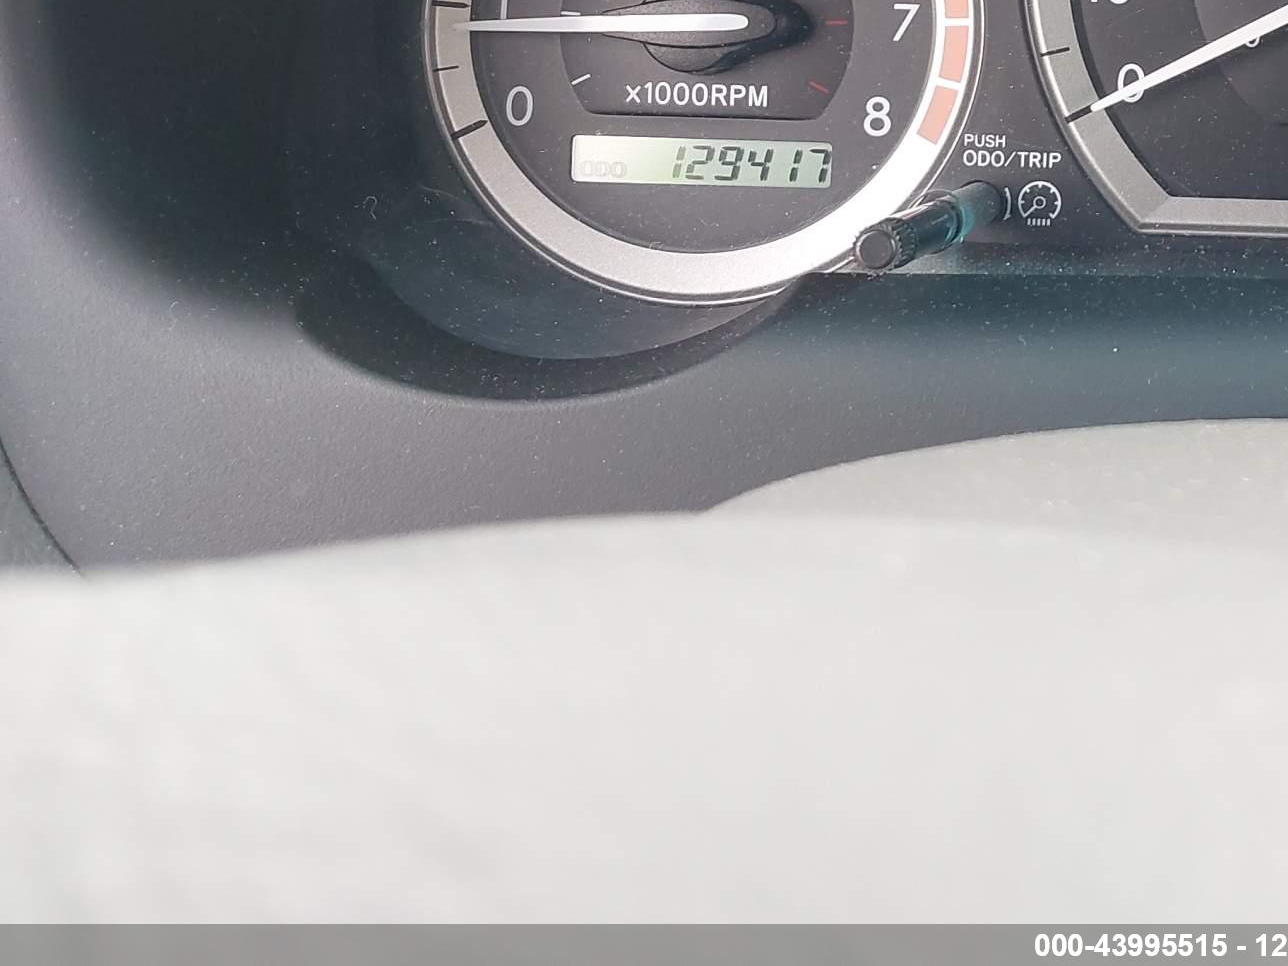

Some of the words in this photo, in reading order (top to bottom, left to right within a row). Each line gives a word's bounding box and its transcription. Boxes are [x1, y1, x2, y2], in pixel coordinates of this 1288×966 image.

[893, 4, 920, 41] 7
[1117, 63, 1145, 103] 0
[506, 86, 533, 126] 0
[864, 97, 891, 136] 8
[963, 150, 1061, 168] ODO/TRIP
[964, 134, 1005, 147] PUSH
[672, 145, 832, 183] 129417
